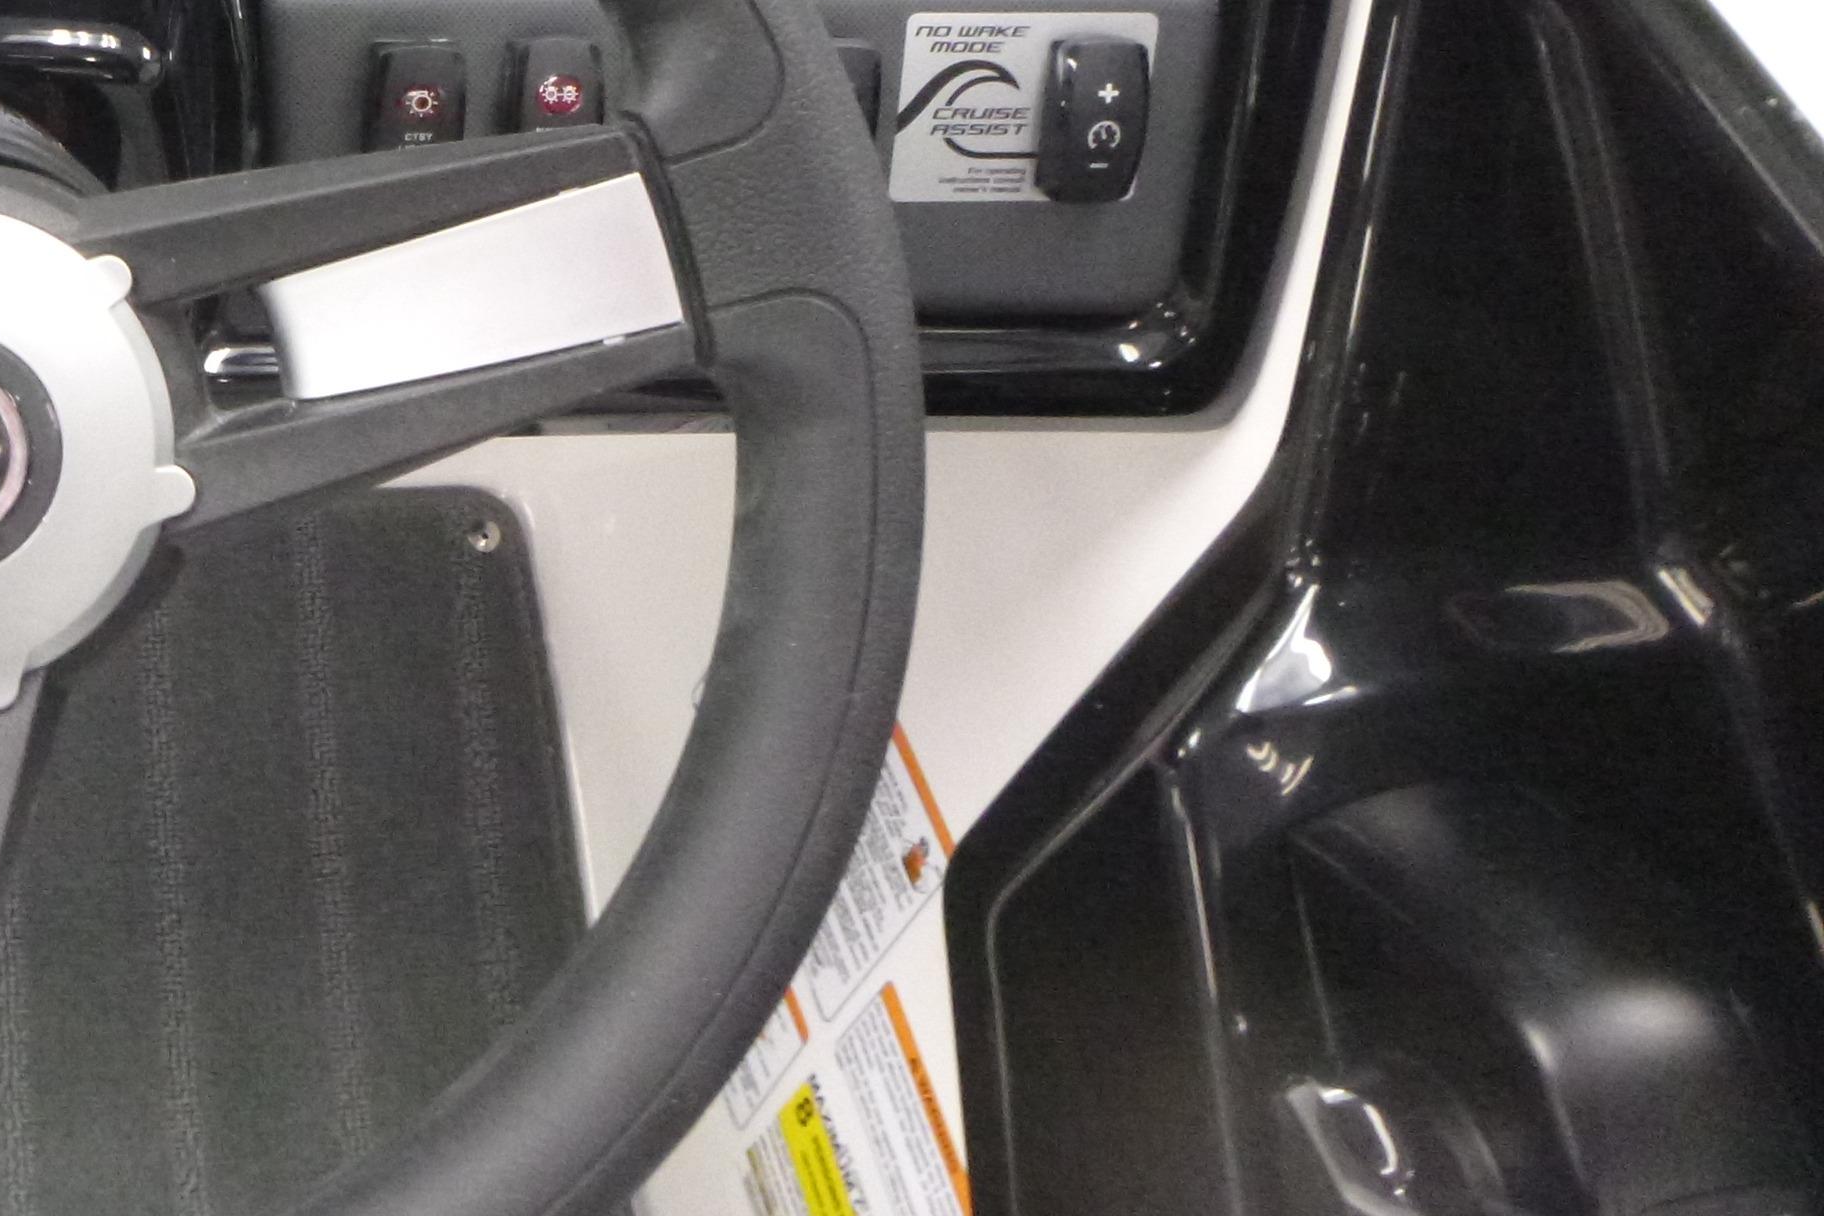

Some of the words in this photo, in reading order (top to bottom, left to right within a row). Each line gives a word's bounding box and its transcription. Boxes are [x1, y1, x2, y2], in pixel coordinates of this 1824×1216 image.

[915, 25, 952, 38] NO
[957, 25, 1031, 38] WAKE
[929, 41, 1005, 54] MODE
[932, 107, 1031, 120] CRUISE
[930, 124, 1027, 136] ASSIST
